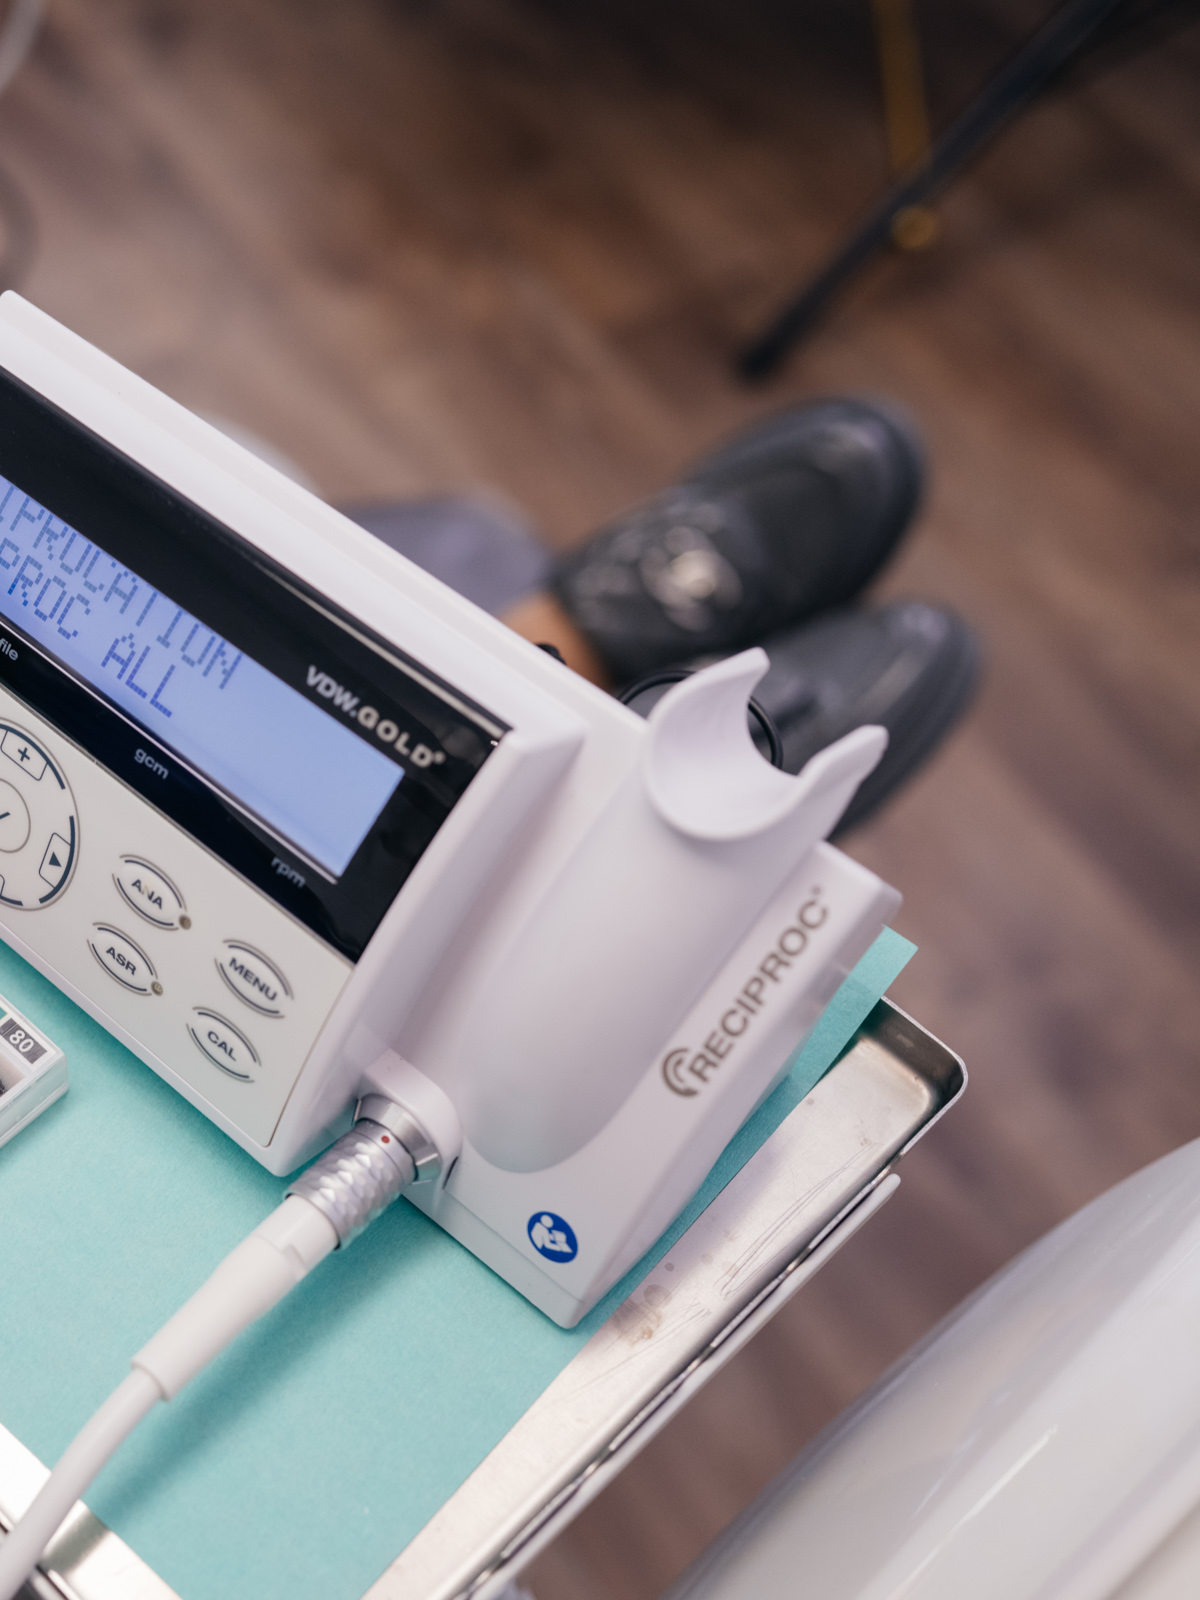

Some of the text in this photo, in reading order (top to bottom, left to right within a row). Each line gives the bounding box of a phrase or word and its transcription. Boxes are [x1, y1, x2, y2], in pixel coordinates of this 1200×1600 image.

[101, 633, 174, 719] ALL
[134, 748, 170, 780] gcm
[271, 856, 305, 888] rpm
[131, 878, 164, 910] ANA
[106, 946, 137, 976] ASR
[229, 957, 278, 1002] MENU
[9, 1028, 35, 1053] 80
[207, 1030, 237, 1062] CAL
